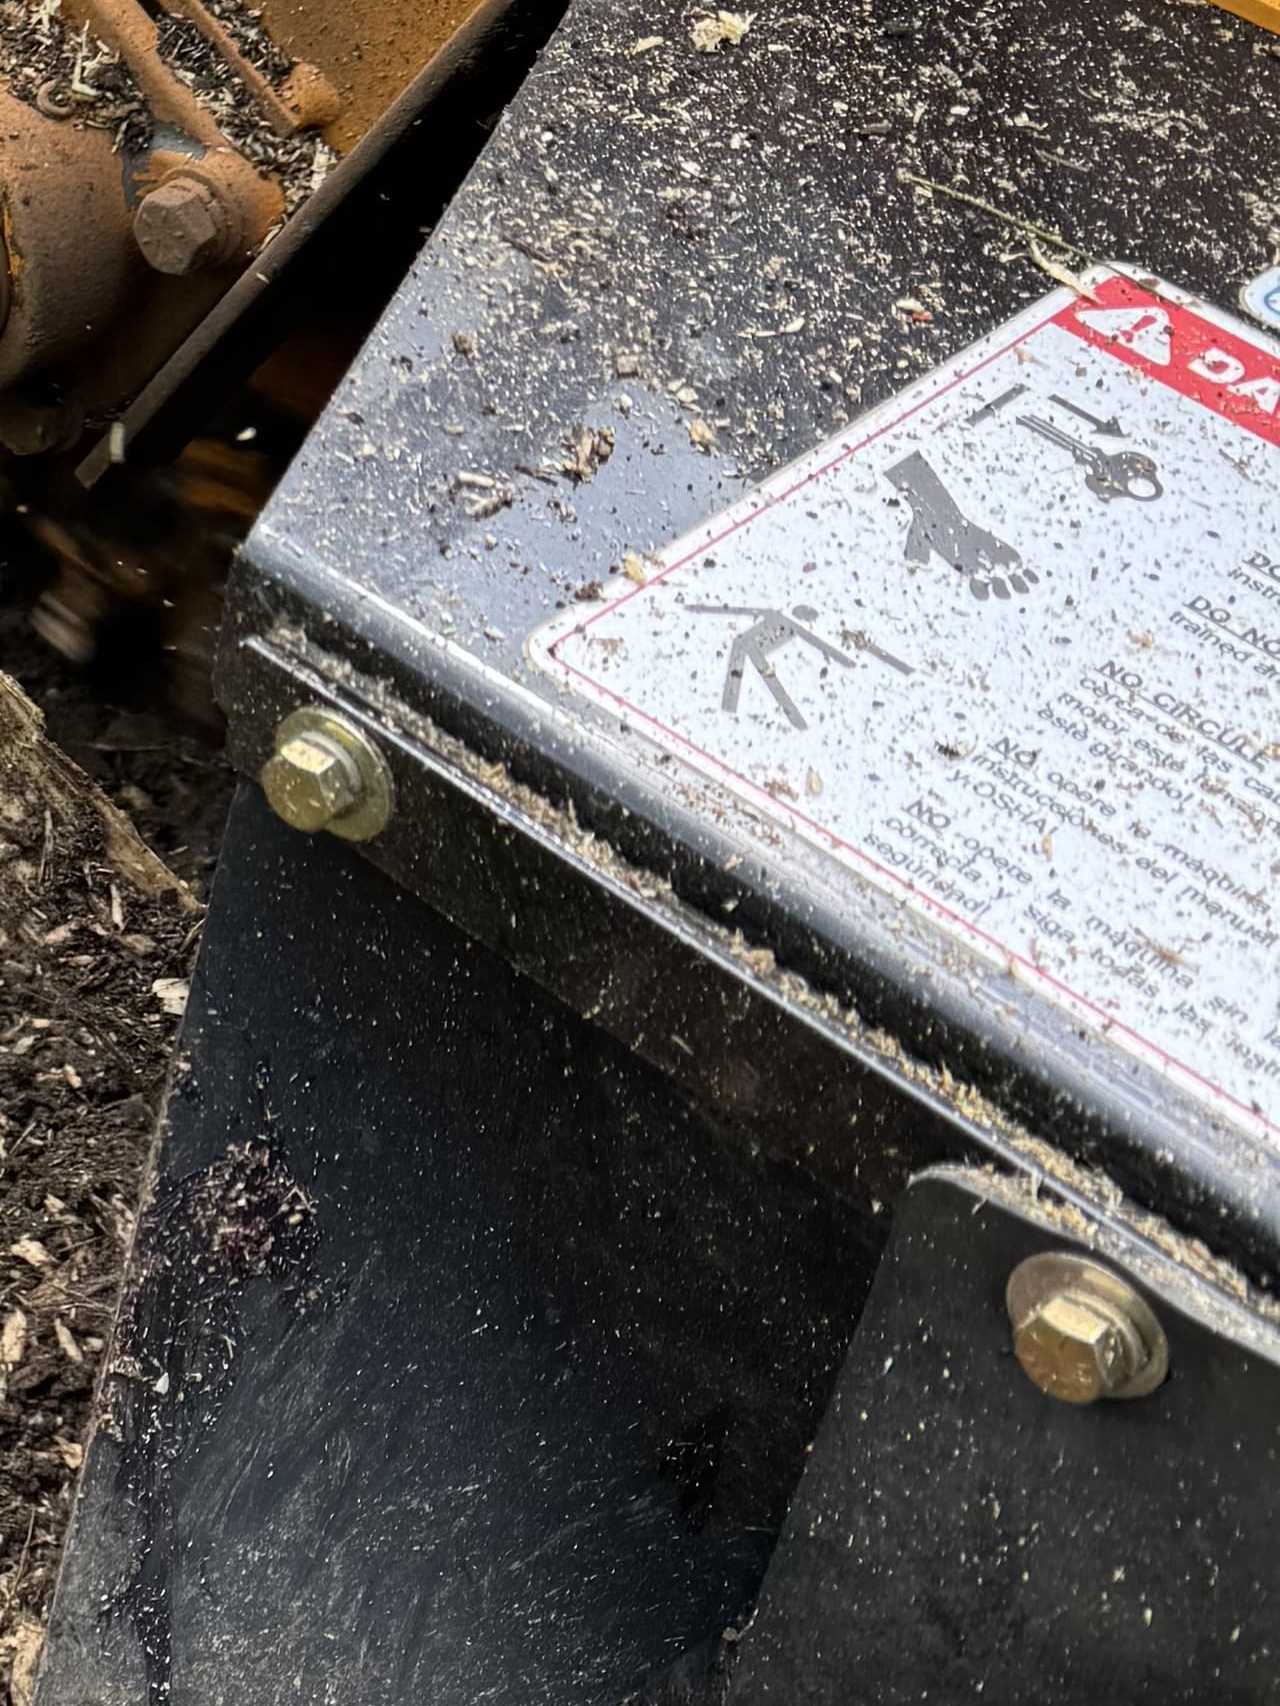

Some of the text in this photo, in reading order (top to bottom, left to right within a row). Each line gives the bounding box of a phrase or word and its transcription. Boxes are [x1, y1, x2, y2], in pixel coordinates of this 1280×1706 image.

[1190, 595, 1231, 624] DO
[1169, 611, 1254, 662] trained
[1099, 660, 1143, 688] NO
[994, 737, 1038, 768] NO
[1048, 772, 1116, 816] opere
[907, 799, 951, 830] NO
[963, 837, 1033, 884] opere
